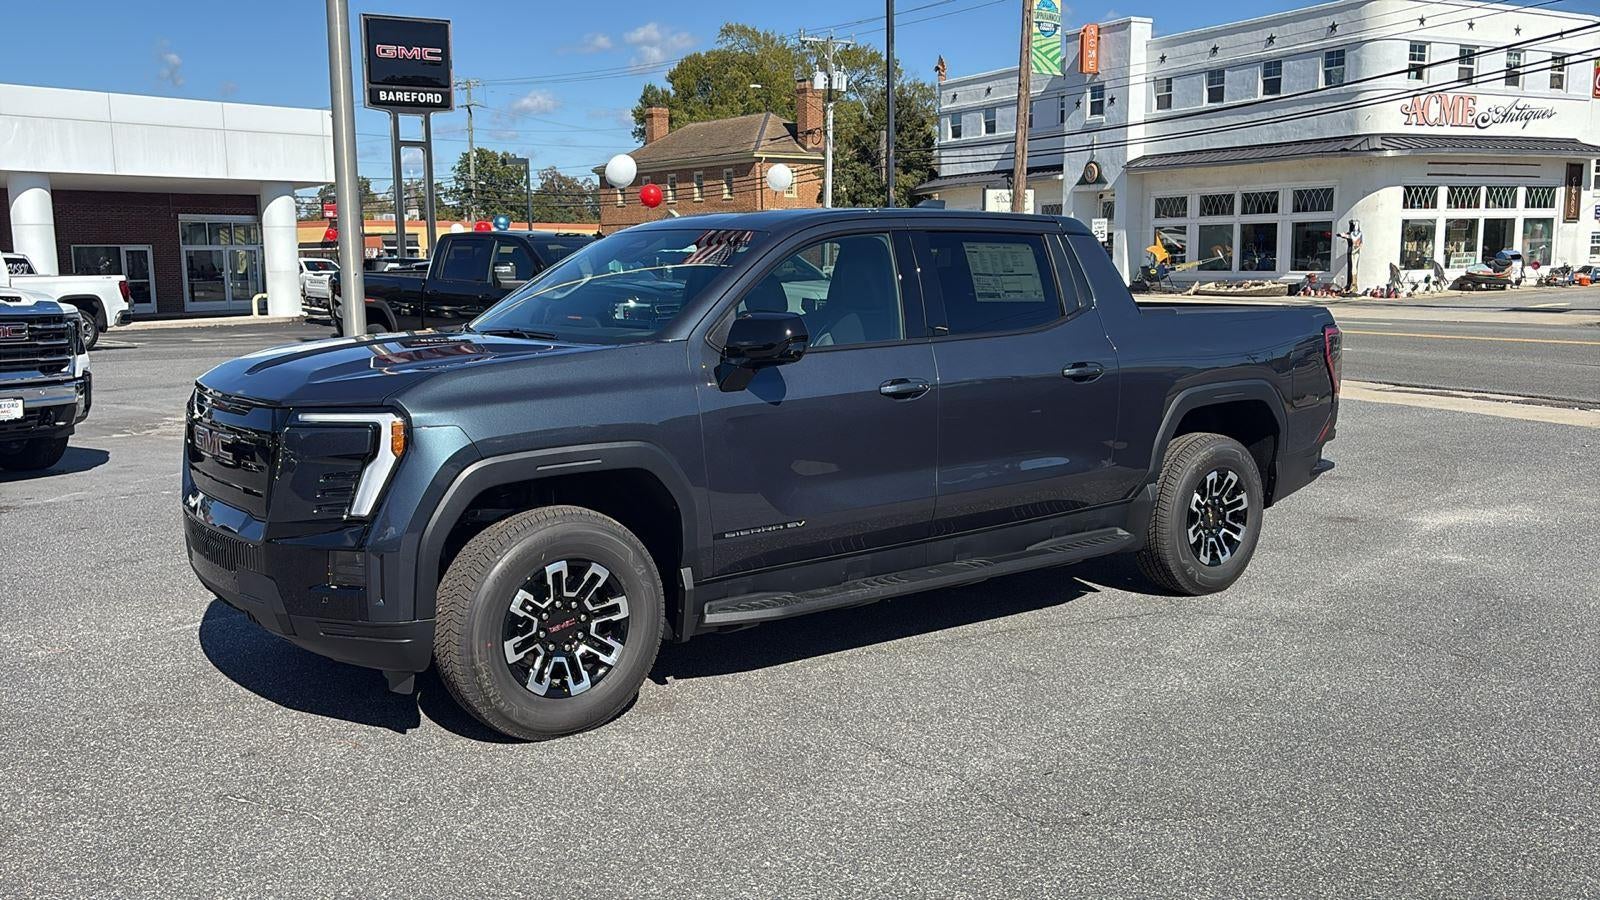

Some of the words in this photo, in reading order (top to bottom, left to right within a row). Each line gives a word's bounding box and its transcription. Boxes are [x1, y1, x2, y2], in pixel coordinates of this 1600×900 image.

[376, 44, 442, 61] GMC
[379, 91, 442, 104] BAREFORD
[1400, 92, 1477, 128] ACME
[1094, 230, 1106, 239] 25
[194, 424, 234, 461] GMC
[725, 525, 784, 538] SIERRA
[787, 520, 806, 528] EV
